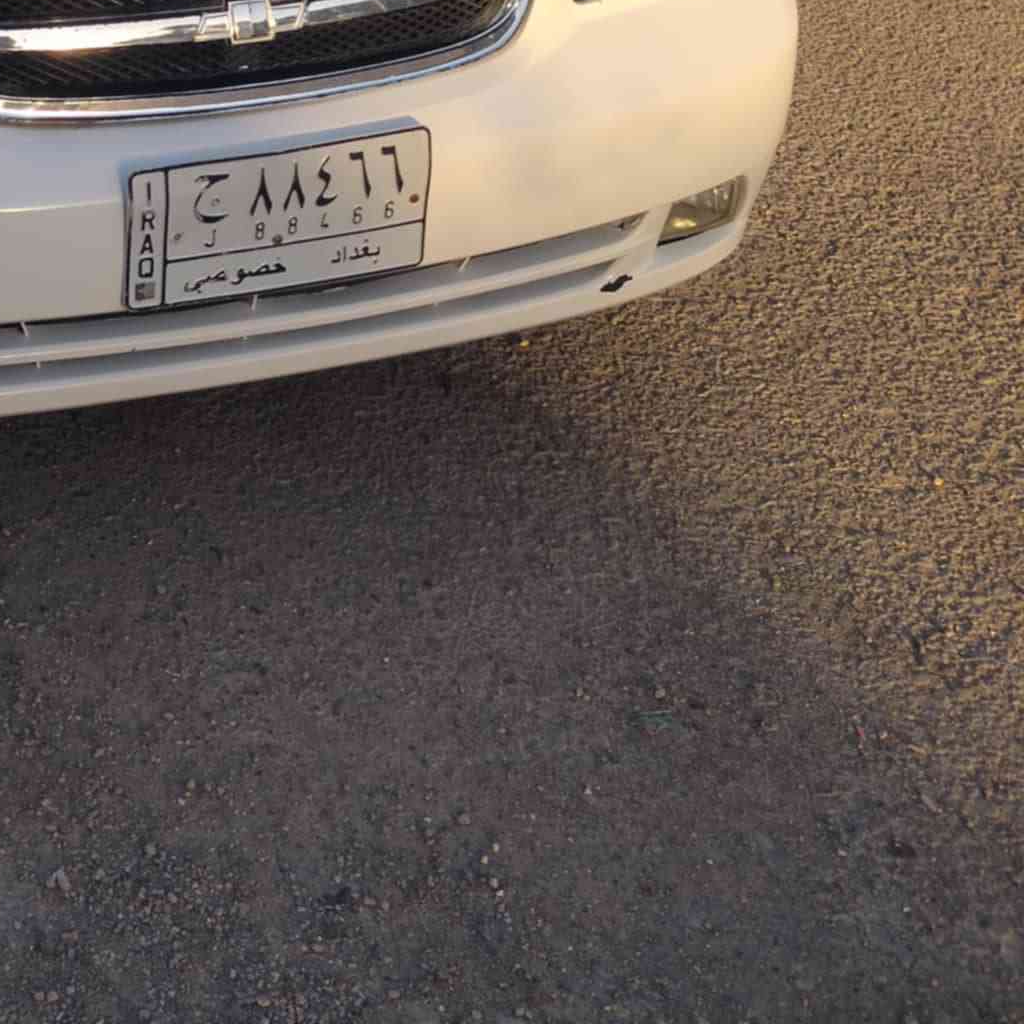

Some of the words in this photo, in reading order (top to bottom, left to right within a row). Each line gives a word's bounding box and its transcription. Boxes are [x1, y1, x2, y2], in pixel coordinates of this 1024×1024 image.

[250, 146, 404, 216] ٨٨٤٦٦
[137, 181, 155, 278] IRAQ
[330, 239, 381, 264] بغداد
[183, 257, 287, 294] خصوصي
